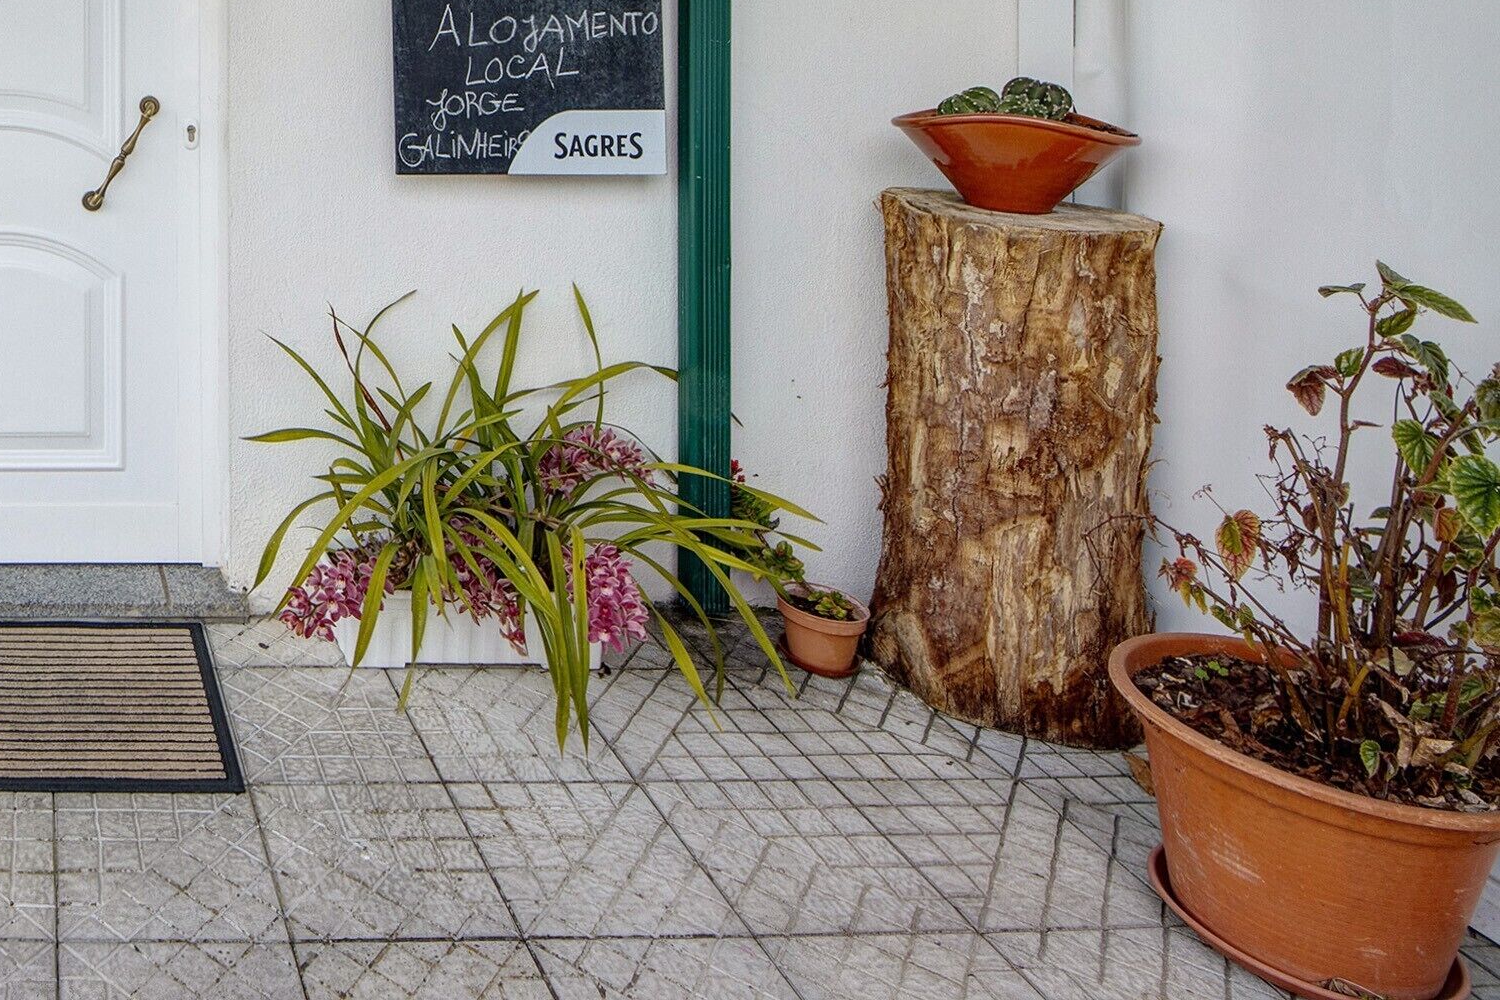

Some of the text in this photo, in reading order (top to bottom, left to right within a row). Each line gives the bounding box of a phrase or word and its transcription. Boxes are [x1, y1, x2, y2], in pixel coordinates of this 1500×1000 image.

[465, 47, 579, 89] LOCAL
[426, 87, 525, 131] JORGE
[554, 132, 643, 159] SAGRES
